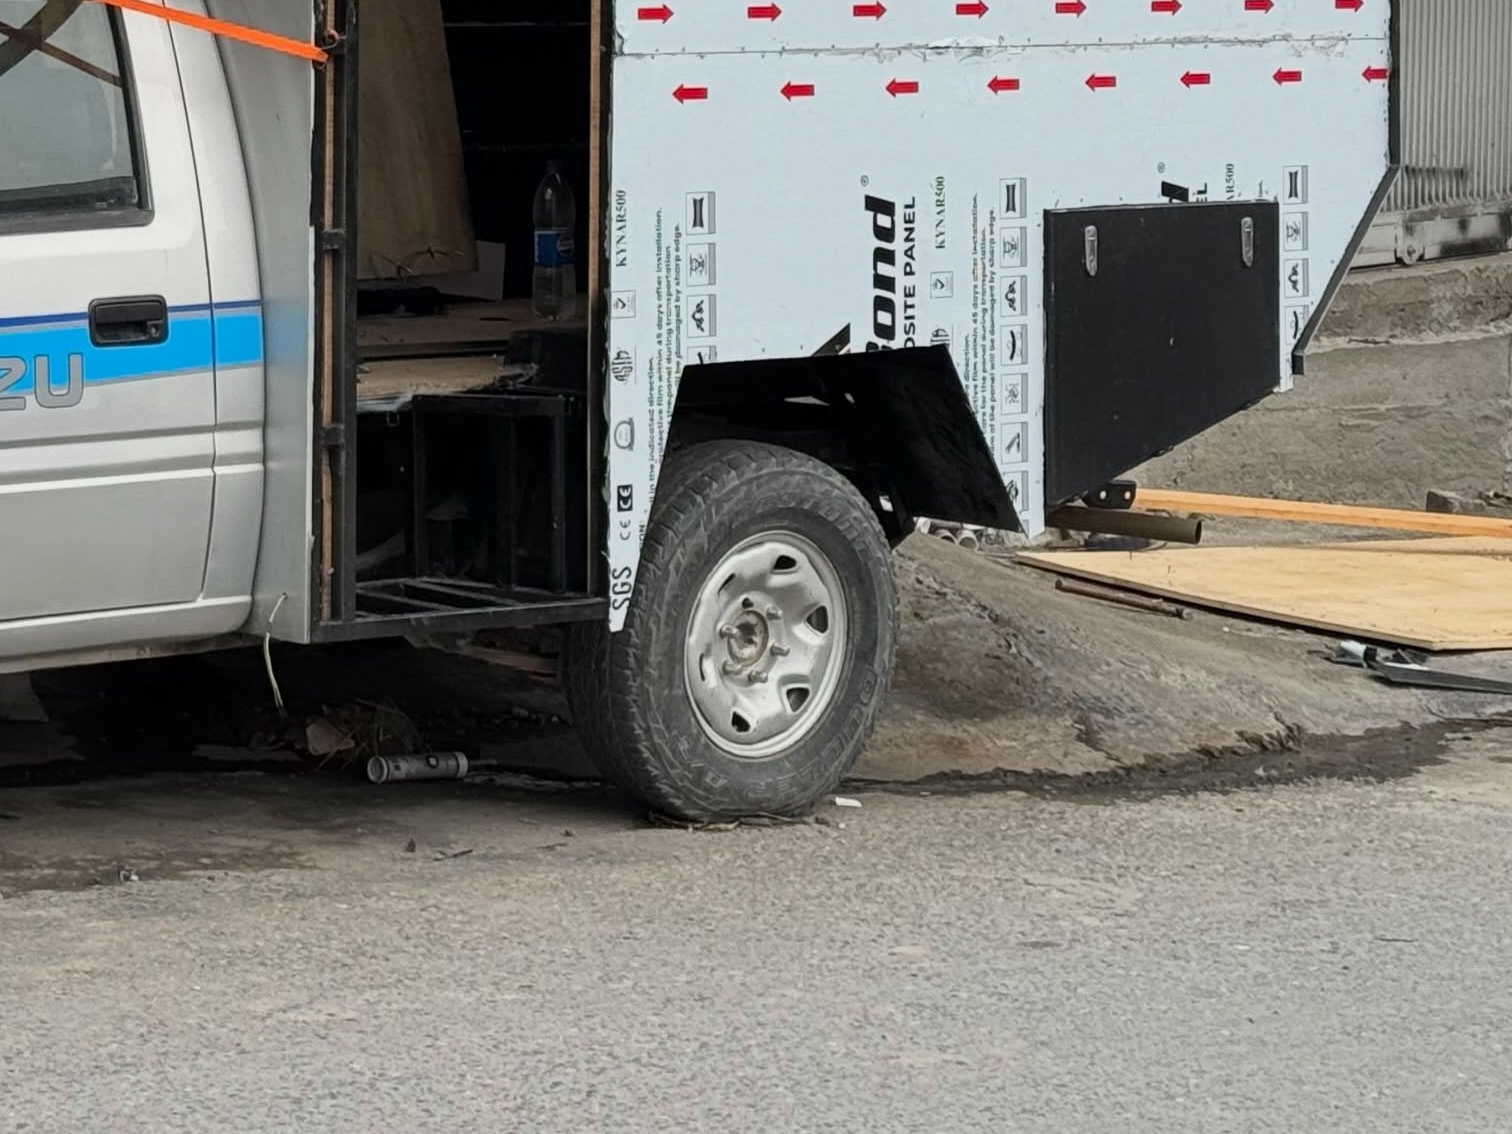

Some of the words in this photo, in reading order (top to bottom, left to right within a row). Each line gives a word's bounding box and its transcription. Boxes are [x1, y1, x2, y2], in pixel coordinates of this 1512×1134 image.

[615, 190, 628, 268] KYNAR500
[904, 196, 916, 276] PANEL
[935, 176, 946, 249] KYNAR500
[612, 566, 632, 611] SGS
